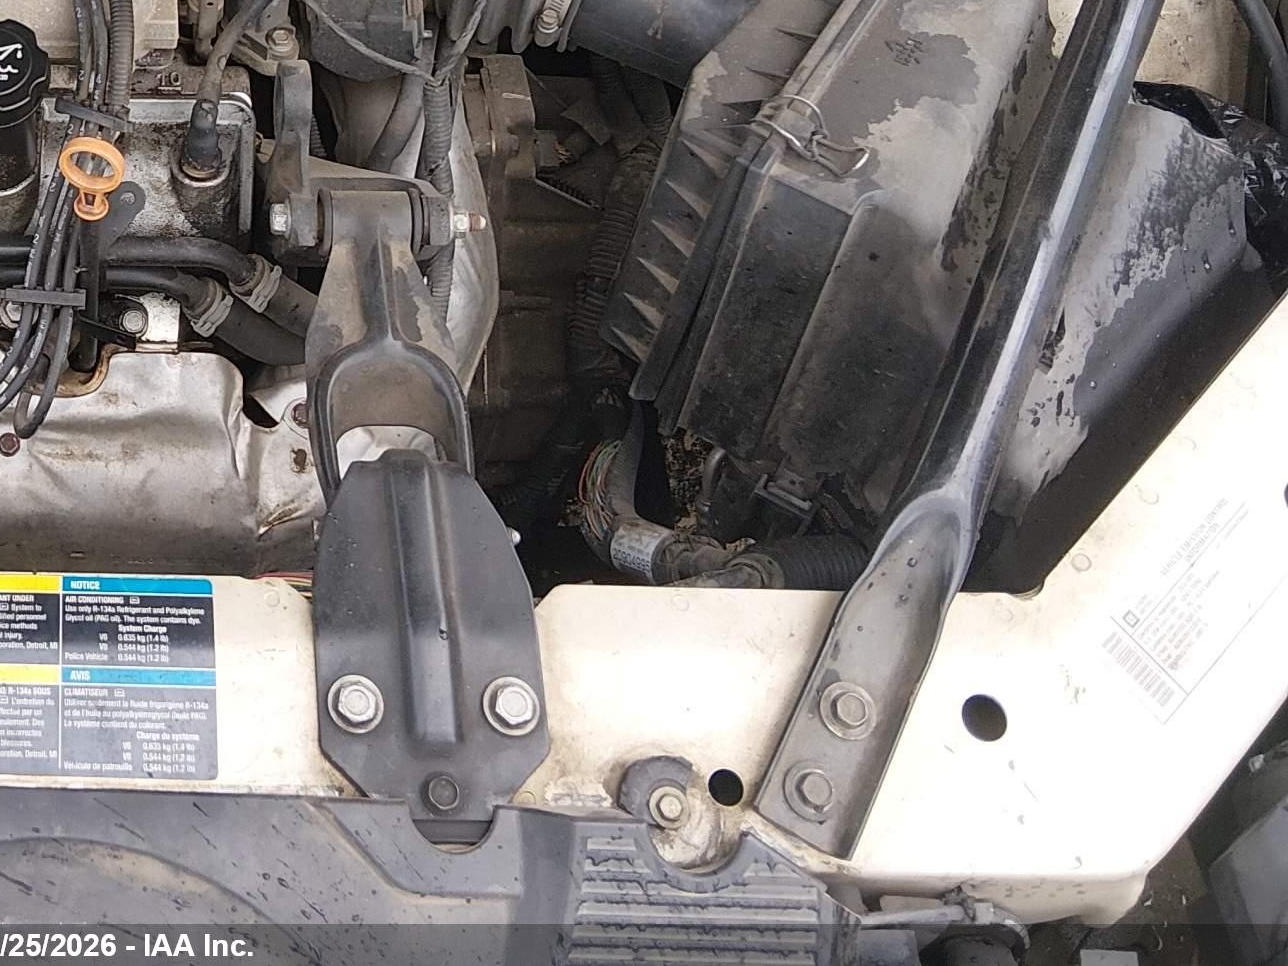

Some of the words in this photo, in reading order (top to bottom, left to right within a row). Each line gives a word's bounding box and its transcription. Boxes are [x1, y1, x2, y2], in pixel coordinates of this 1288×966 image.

[71, 580, 100, 590] NOTICE
[78, 596, 124, 604] CONDITIONING
[11, 604, 34, 612] System
[116, 606, 152, 614] Refrigerant
[166, 607, 204, 616] Polyalkylene
[65, 614, 84, 623] Glycol
[94, 615, 109, 623] (PAG
[11, 622, 38, 630] methods
[144, 625, 167, 634] Charge
[137, 634, 145, 642] kg
[26, 641, 48, 649] Detroit,
[137, 644, 145, 652] kg
[65, 652, 83, 660] Police
[85, 652, 108, 660] Vehicle
[137, 655, 145, 663] kg
[70, 671, 90, 681] AVIS
[8, 686, 32, 694] R-134a
[33, 687, 52, 695] SOUS
[64, 688, 108, 697] CLIMATISEUR
[185, 701, 208, 710] R-134a
[136, 731, 160, 740] Charge
[162, 742, 171, 752] kg
